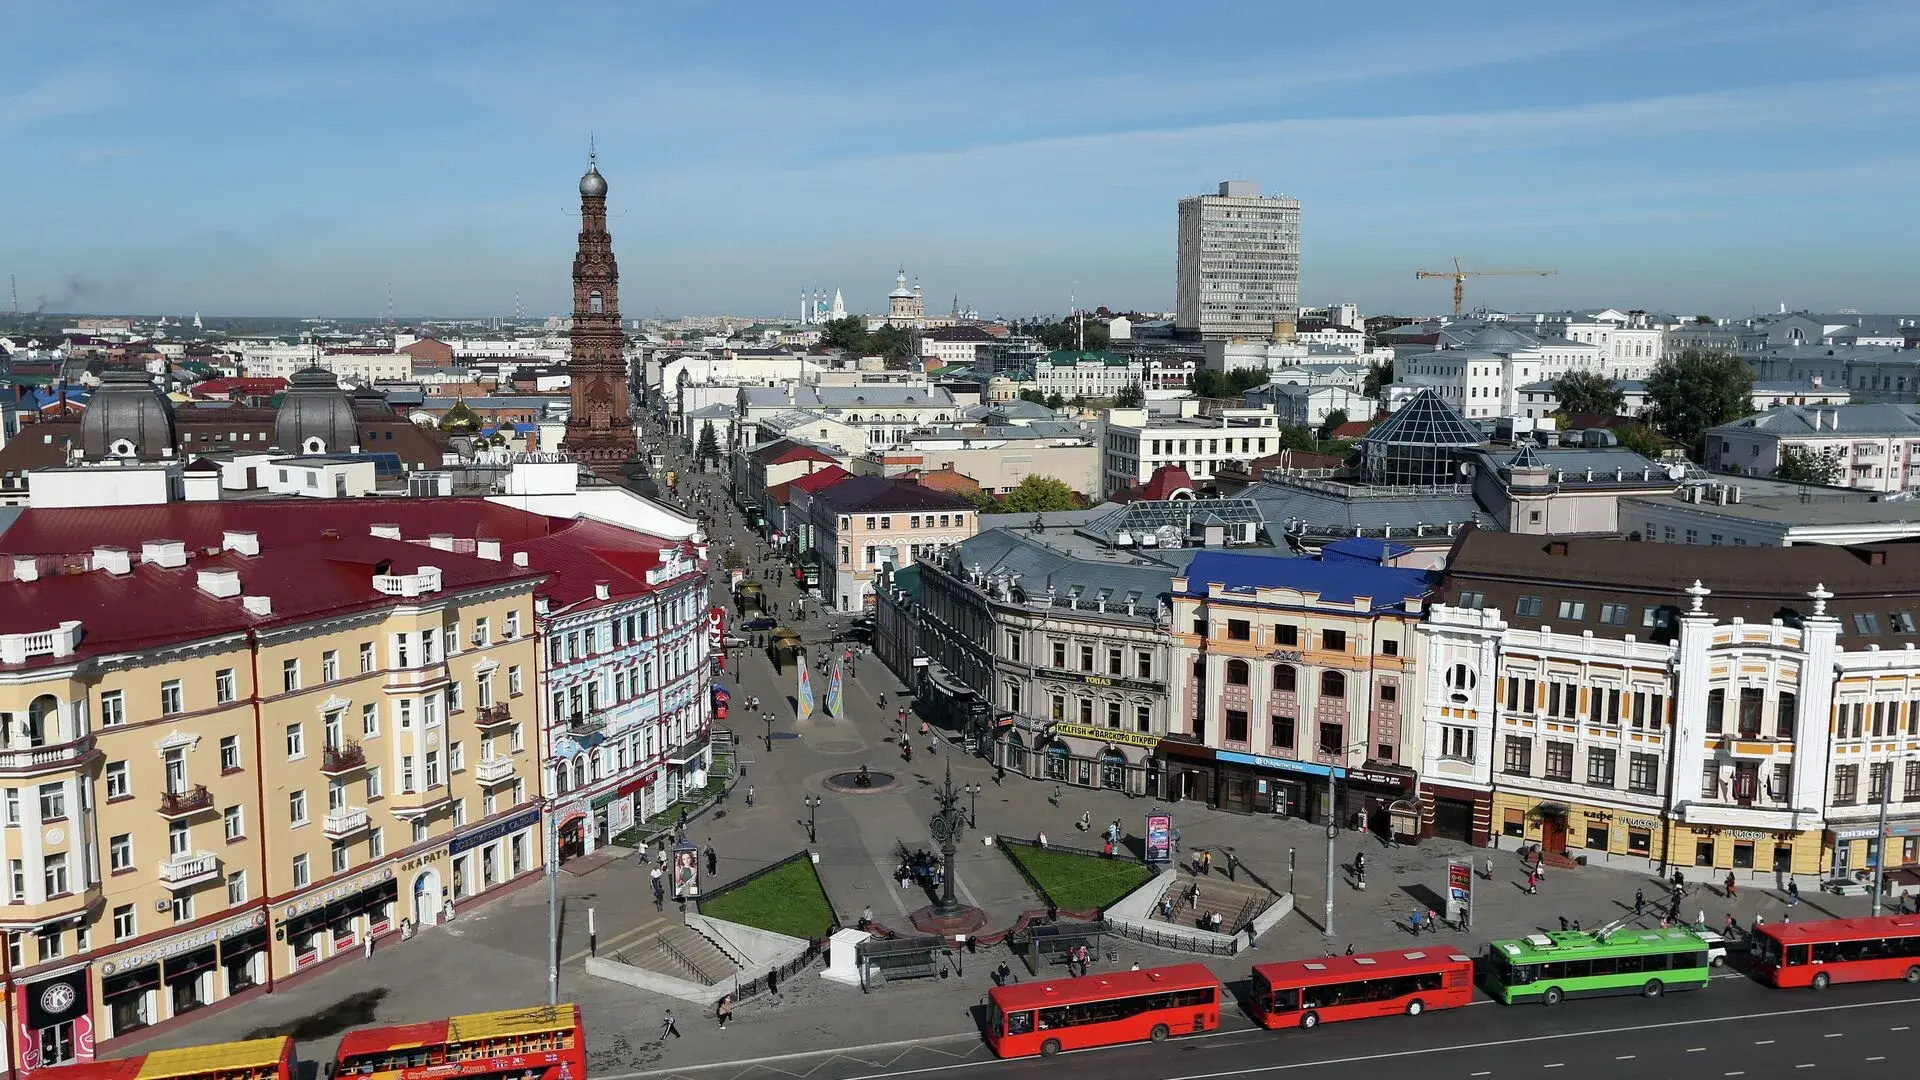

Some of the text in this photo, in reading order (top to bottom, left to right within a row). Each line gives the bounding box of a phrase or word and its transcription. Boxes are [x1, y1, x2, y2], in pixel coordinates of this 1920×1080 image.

[708, 613, 721, 648] KFC
[1085, 675, 1112, 687] ТОПАЗ
[1057, 723, 1087, 736] KILLFISH
[645, 773, 654, 782] KFC
[1583, 810, 1613, 822] кафе
[455, 813, 536, 851] ЮВЕЛИРНЫЙ САЛОН
[1690, 827, 1722, 839] кафе
[408, 850, 443, 869] КАРАТ
